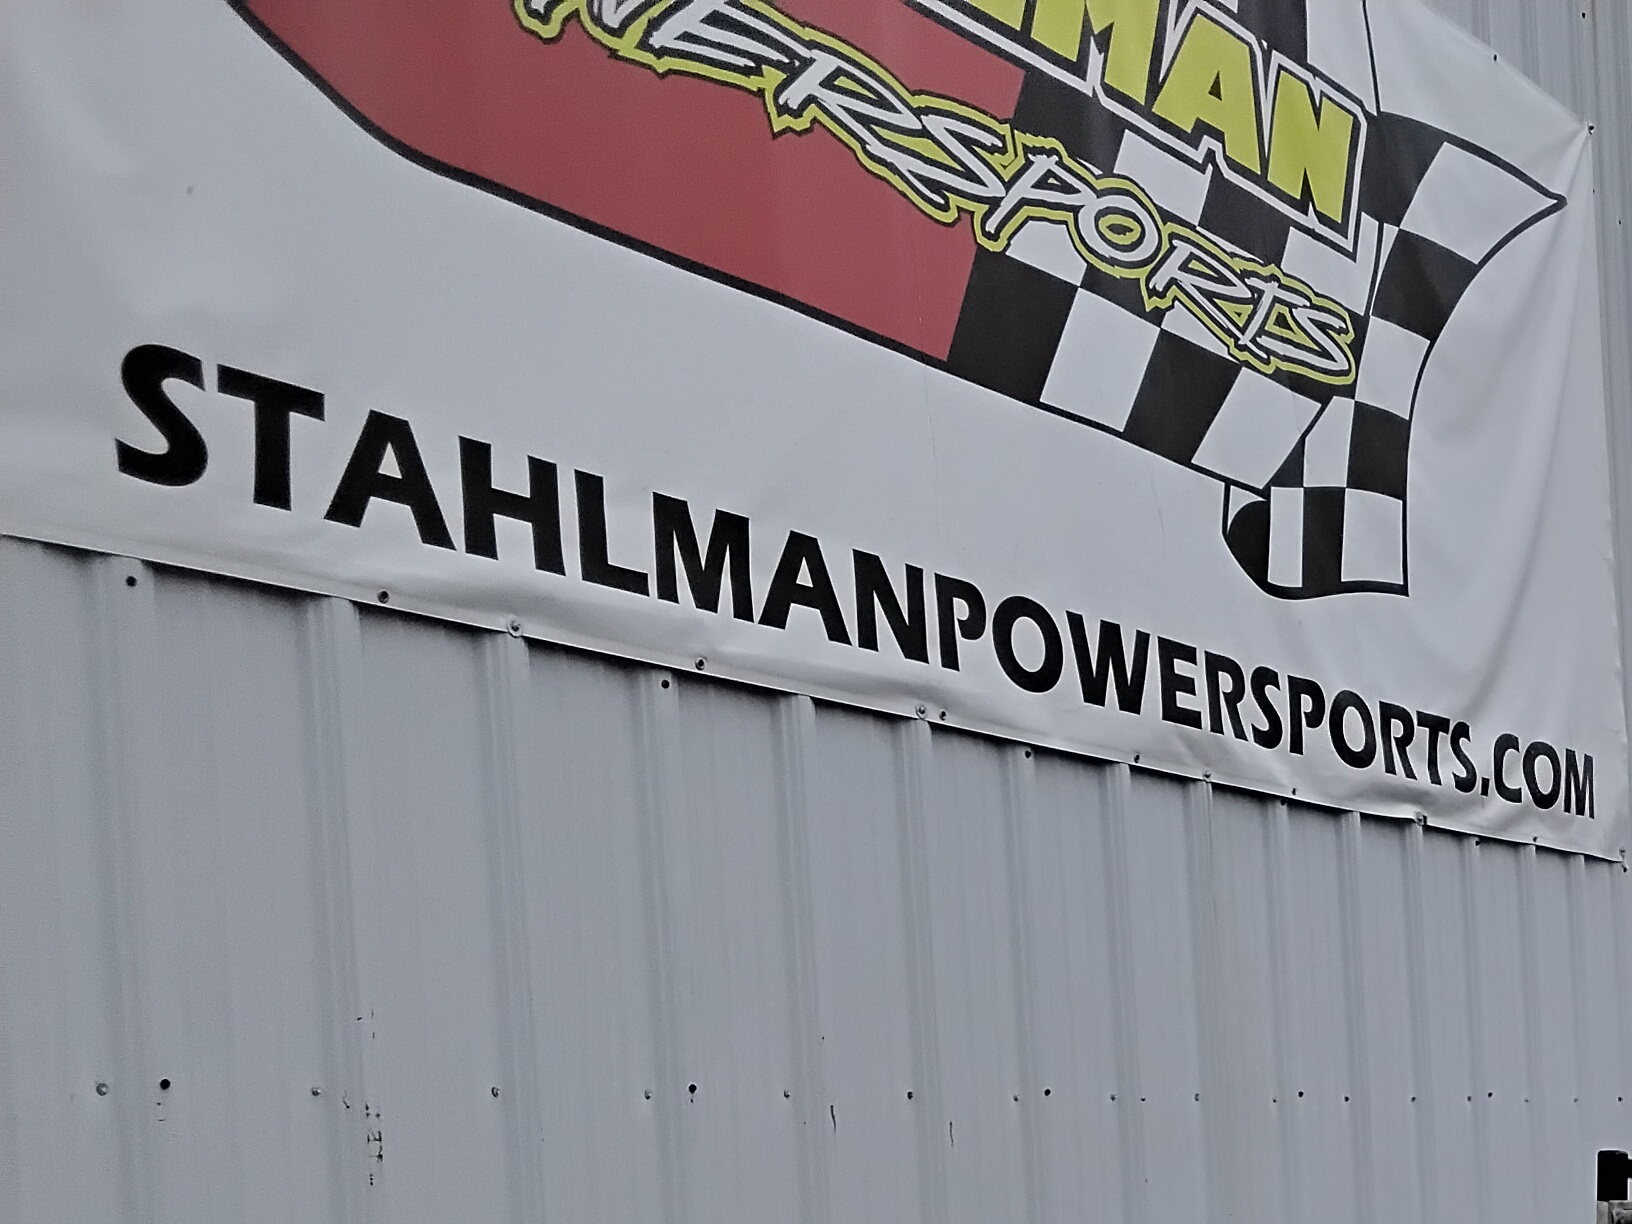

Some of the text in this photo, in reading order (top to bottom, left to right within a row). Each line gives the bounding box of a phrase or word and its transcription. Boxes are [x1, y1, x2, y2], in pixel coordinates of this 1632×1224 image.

[518, 0, 1352, 376] ERSPORTS
[942, 0, 1356, 226] MAN
[114, 342, 1596, 820] STAHLMANPOWERSPORTS.COM
